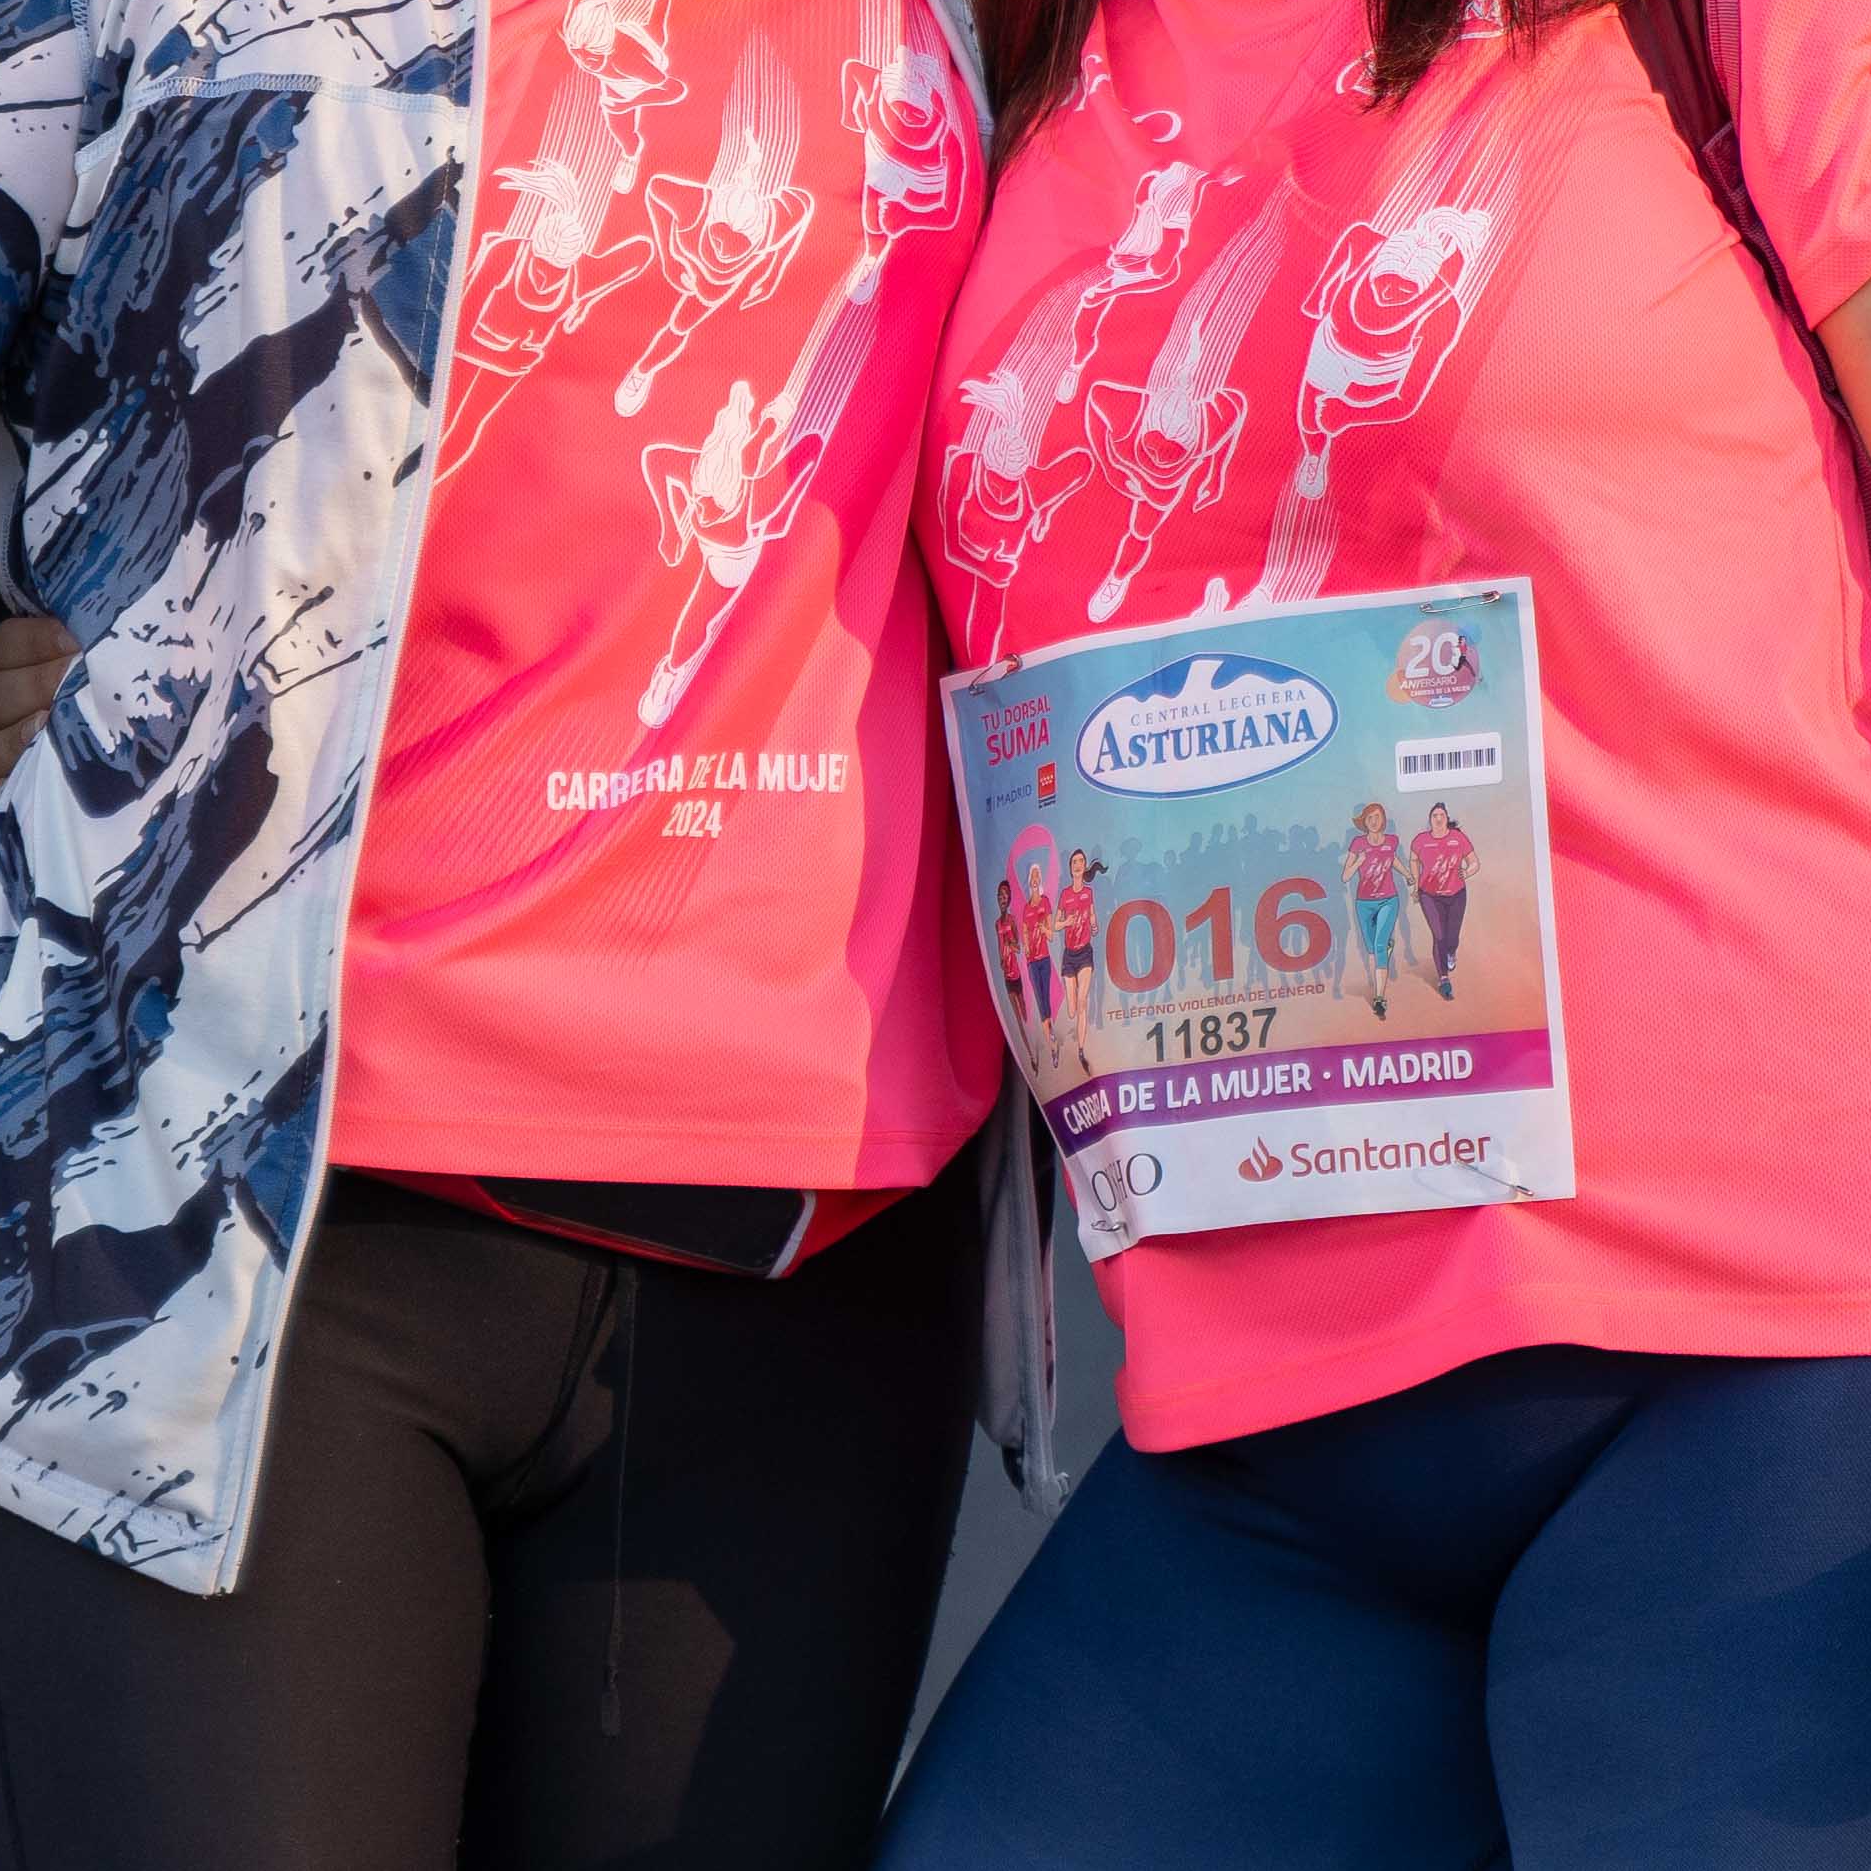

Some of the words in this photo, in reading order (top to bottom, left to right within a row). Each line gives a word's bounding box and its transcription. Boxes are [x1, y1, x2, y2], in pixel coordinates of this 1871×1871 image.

[1405, 632, 1461, 679] 20
[981, 711, 1001, 732] TU
[1005, 694, 1051, 727] DORSAL
[1130, 703, 1211, 727] CENTRAL
[1219, 688, 1308, 713] LECHERA
[986, 717, 1051, 767] SUMA
[1092, 708, 1318, 776] ASTURIANA
[546, 754, 685, 812] CARRERA
[687, 753, 716, 792] DE
[713, 751, 748, 792] LA
[756, 752, 849, 794] MUJE
[661, 799, 723, 839] 2024
[1105, 876, 1333, 994] 016
[1106, 1001, 1176, 1022] TELÉFONO
[1179, 993, 1247, 1013] VIOLENCIA
[1248, 989, 1266, 1002] DE
[1268, 982, 1326, 1001] GÉNERO
[1146, 1006, 1278, 1063] 11837
[1118, 1081, 1156, 1115] DE
[1166, 1076, 1202, 1109] LA
[1211, 1062, 1313, 1103] MUJER
[1343, 1048, 1474, 1089] MADRID
[1290, 1131, 1491, 1179] Santander
